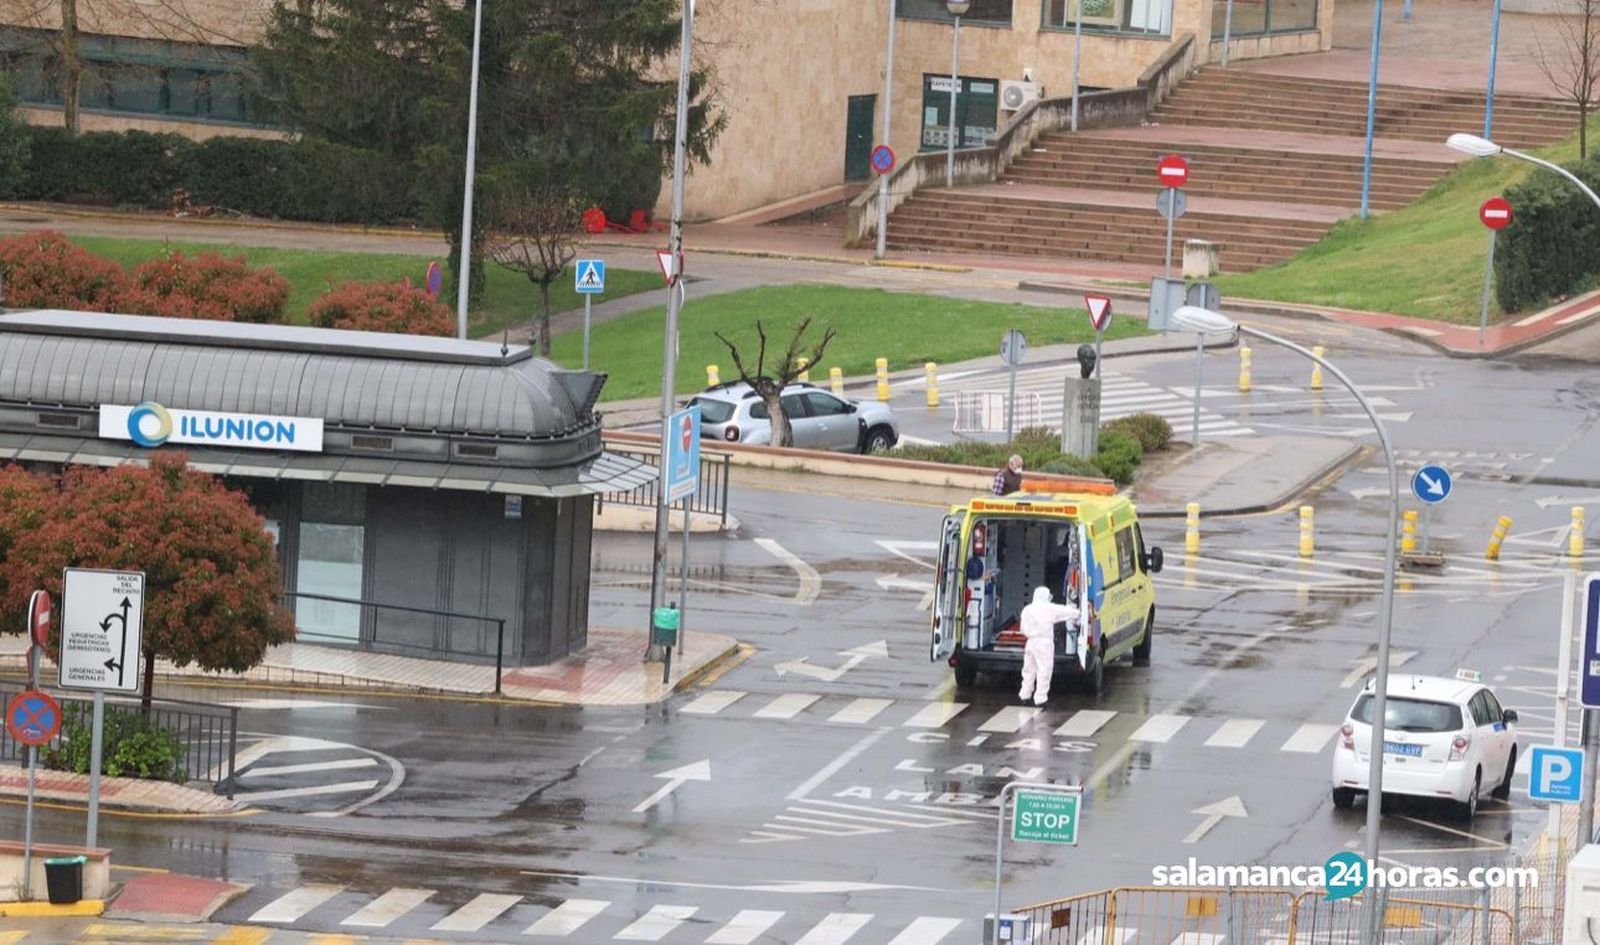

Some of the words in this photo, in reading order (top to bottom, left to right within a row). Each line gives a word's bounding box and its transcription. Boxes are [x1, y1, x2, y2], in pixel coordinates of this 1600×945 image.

[181, 415, 295, 443] ILUNION
[71, 632, 108, 640] URGENCIAS
[69, 667, 105, 675] URGENCIAS
[1540, 754, 1571, 792] P
[1021, 811, 1070, 829] STOP
